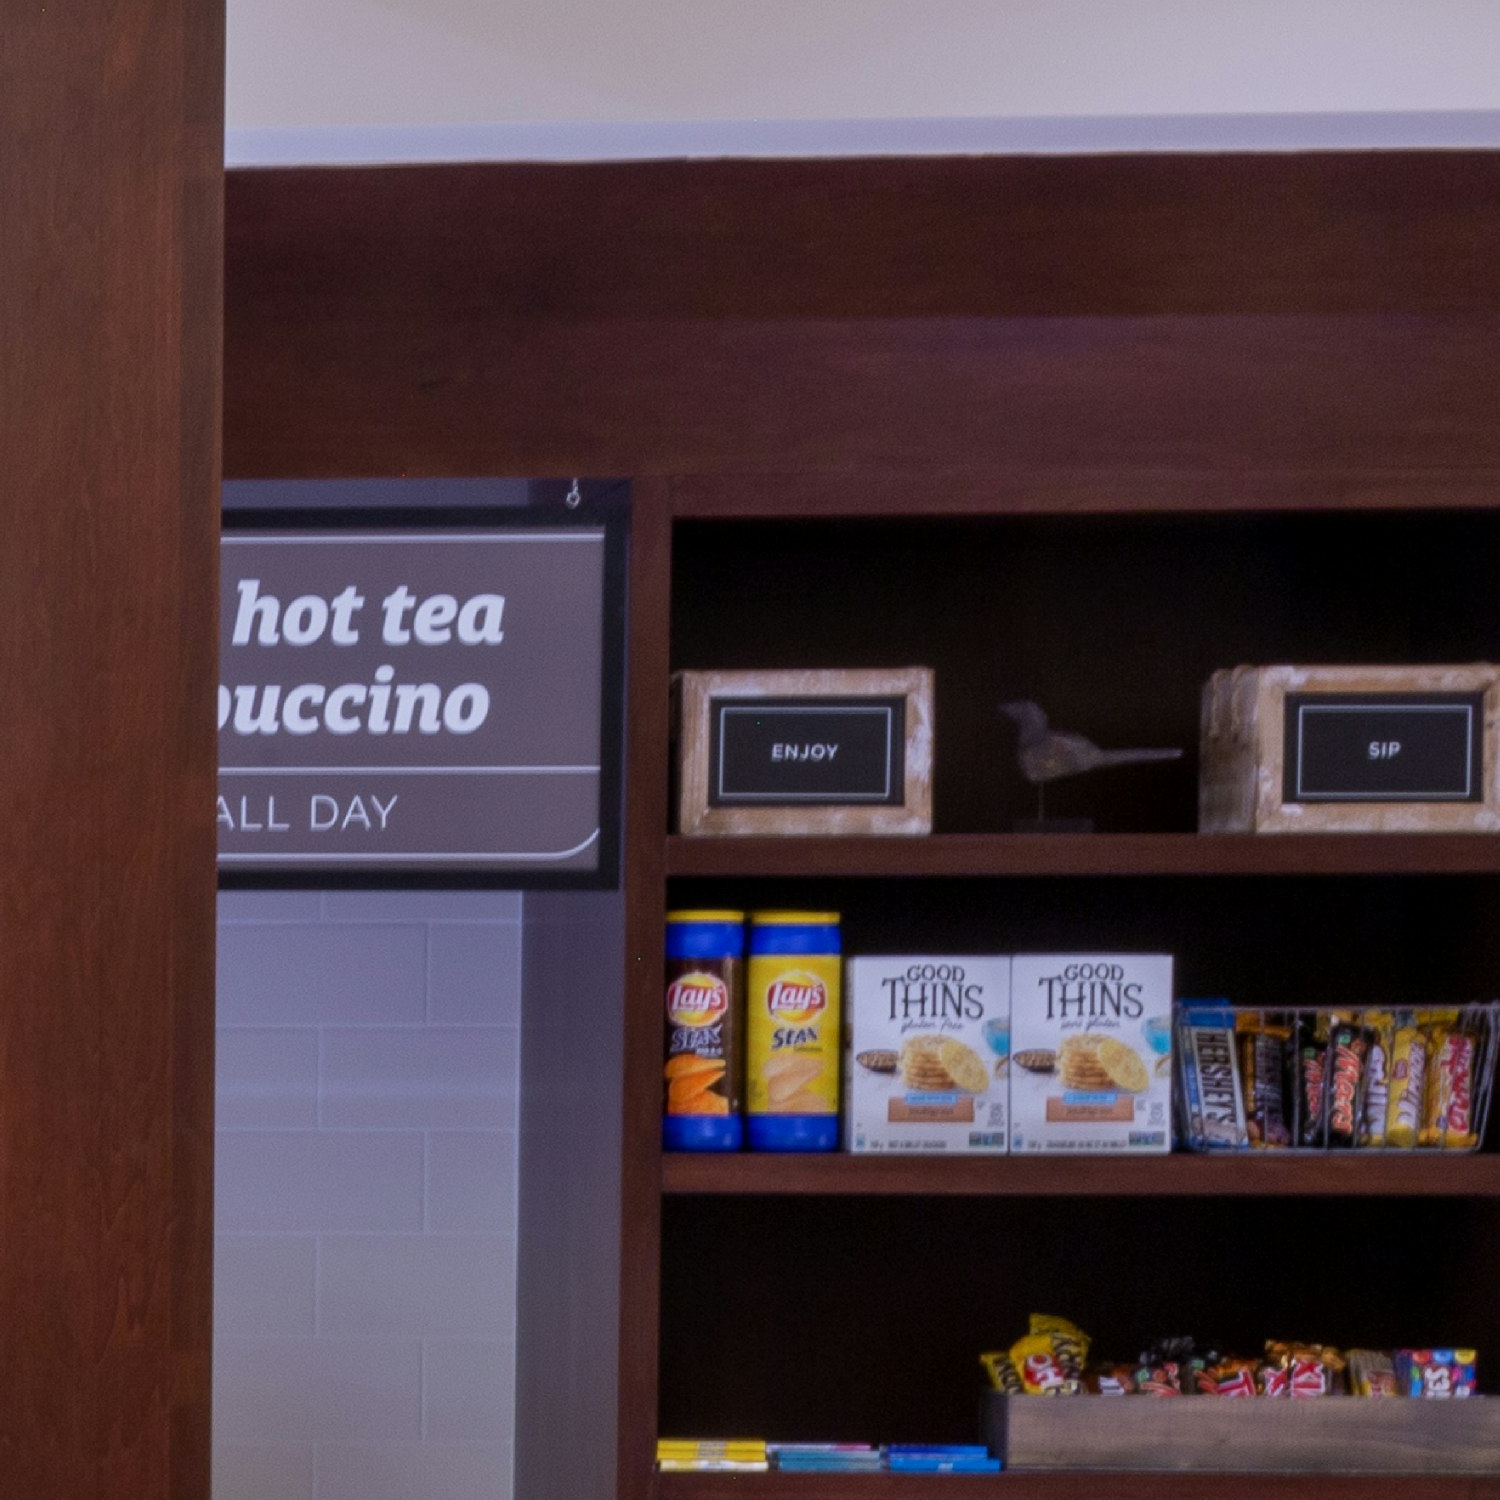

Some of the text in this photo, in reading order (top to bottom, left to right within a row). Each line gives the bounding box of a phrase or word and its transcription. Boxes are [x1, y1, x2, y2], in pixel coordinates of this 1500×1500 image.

[231, 579, 365, 646] hot
[382, 585, 506, 646] tea
[217, 664, 490, 735] uccino
[771, 741, 840, 763] ENJOY
[1368, 739, 1402, 760] SIP
[216, 794, 290, 831] ALL
[310, 794, 398, 831] DAY
[907, 964, 965, 983] GOOD
[1063, 963, 1124, 983] GOOD
[881, 975, 985, 1021] THINS
[1038, 974, 1144, 1021] THINS
